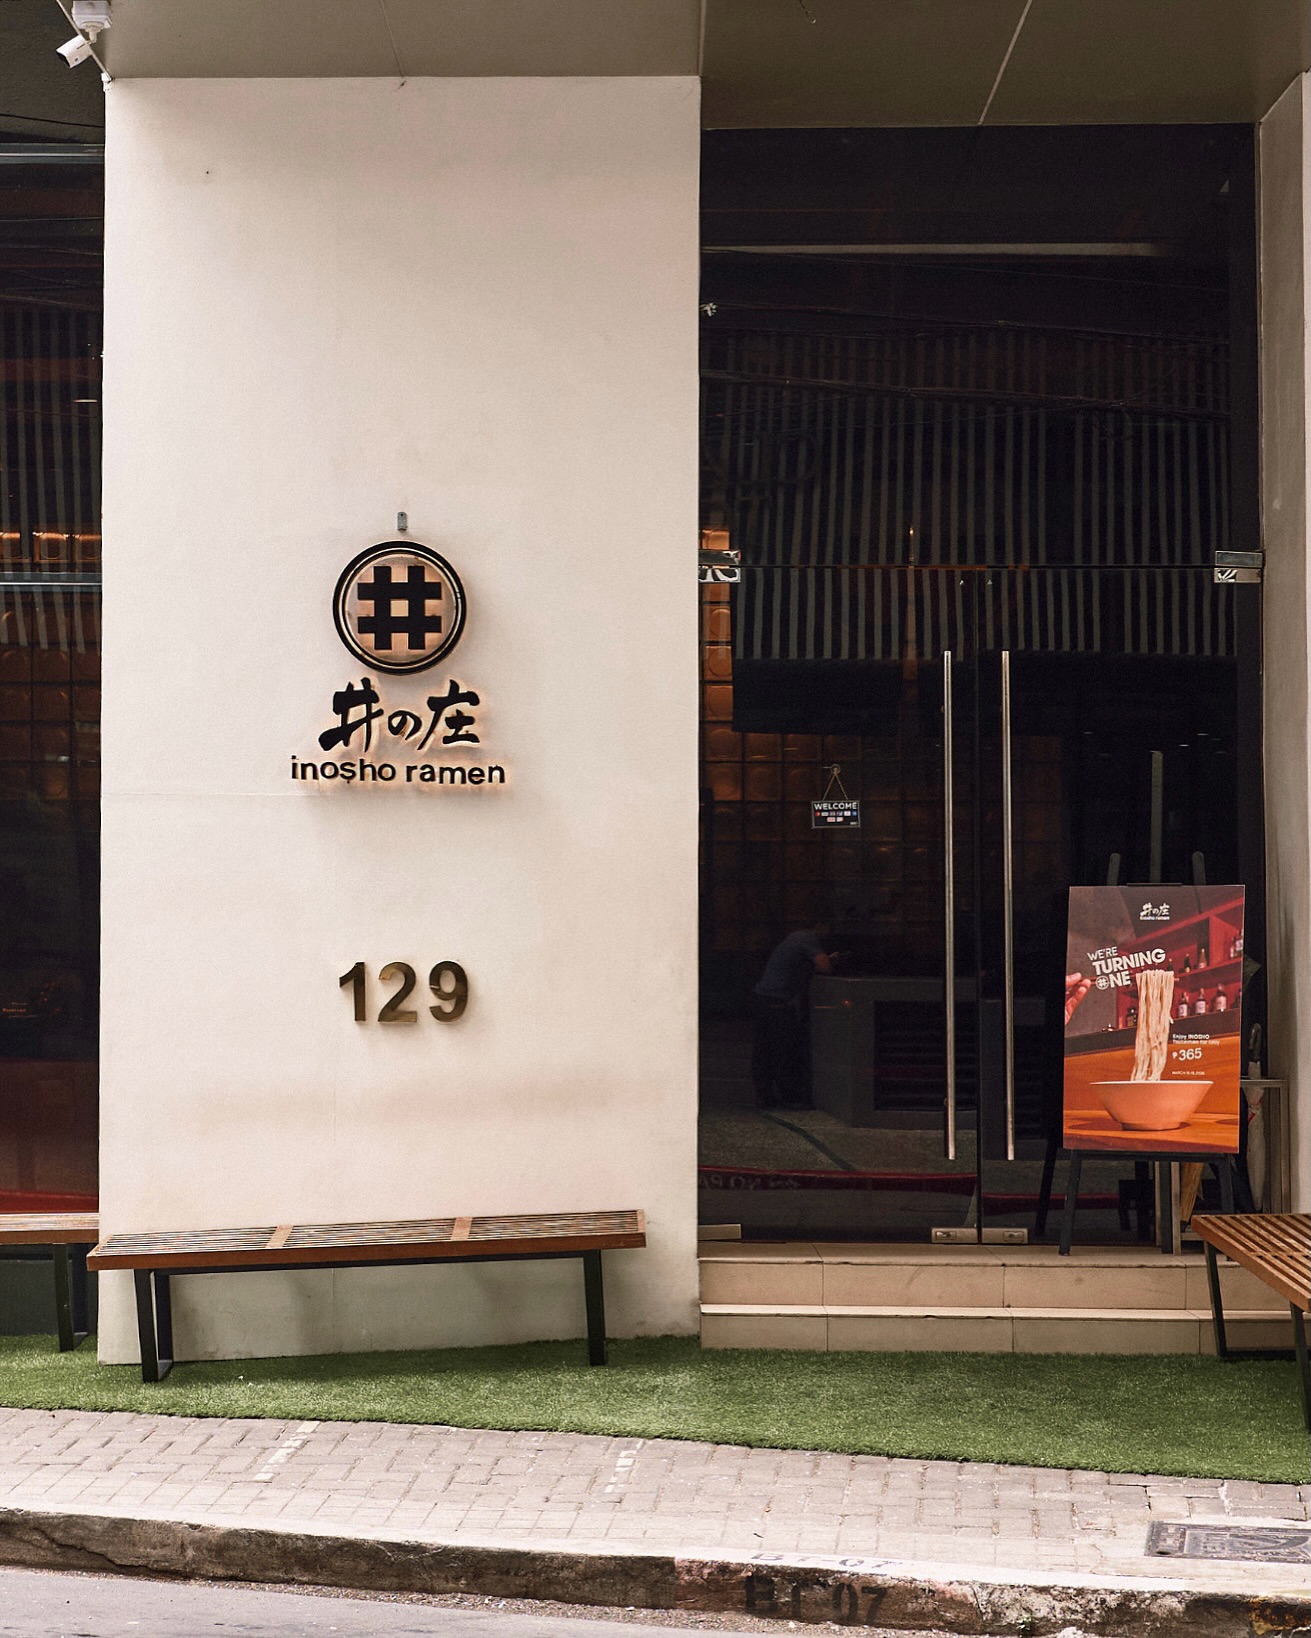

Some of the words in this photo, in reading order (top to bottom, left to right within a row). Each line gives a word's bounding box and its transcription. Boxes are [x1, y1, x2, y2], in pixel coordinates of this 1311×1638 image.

[318, 676, 480, 752] 井の庄
[291, 754, 396, 784] inosho
[406, 763, 506, 785] ramen
[814, 802, 857, 810] WELCOME
[1087, 946, 1118, 961] WE'RE
[1092, 948, 1166, 975] TURNING
[339, 960, 468, 1022] 129
